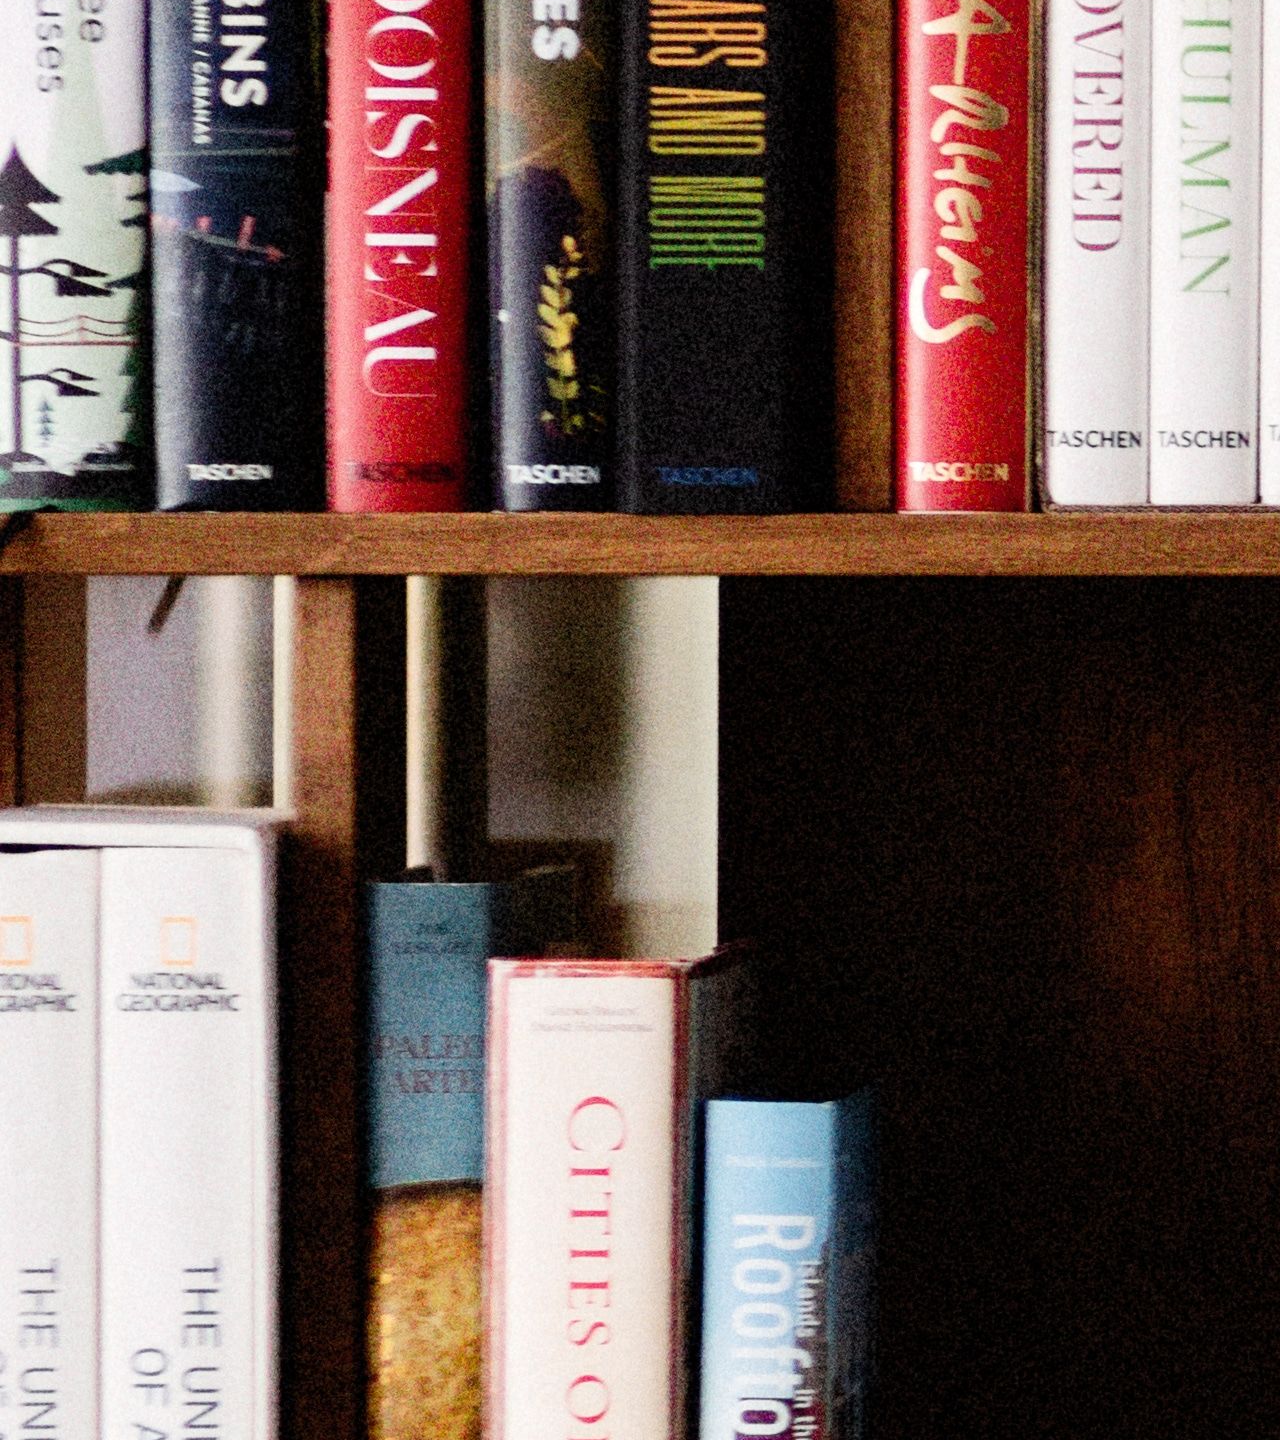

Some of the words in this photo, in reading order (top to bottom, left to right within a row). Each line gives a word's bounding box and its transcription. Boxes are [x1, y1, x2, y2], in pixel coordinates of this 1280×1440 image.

[649, 86, 767, 156] AND
[648, 175, 767, 271] MORE
[1048, 429, 1142, 449] TASCHEN
[1157, 429, 1251, 449] TASCHEN
[188, 463, 273, 481] TASCHEN
[507, 464, 600, 484] TASCHEN
[658, 466, 760, 486] TASCHEN
[908, 461, 1009, 482] TASCHEN
[130, 971, 227, 991] NATIONAL
[116, 993, 241, 1013] GEOGRAPHIC
[566, 1096, 628, 1348] CITIES
[20, 1256, 60, 1349] THE
[182, 1256, 223, 1349] THE
[794, 1259, 824, 1338] Islands
[129, 1346, 171, 1408] OF
